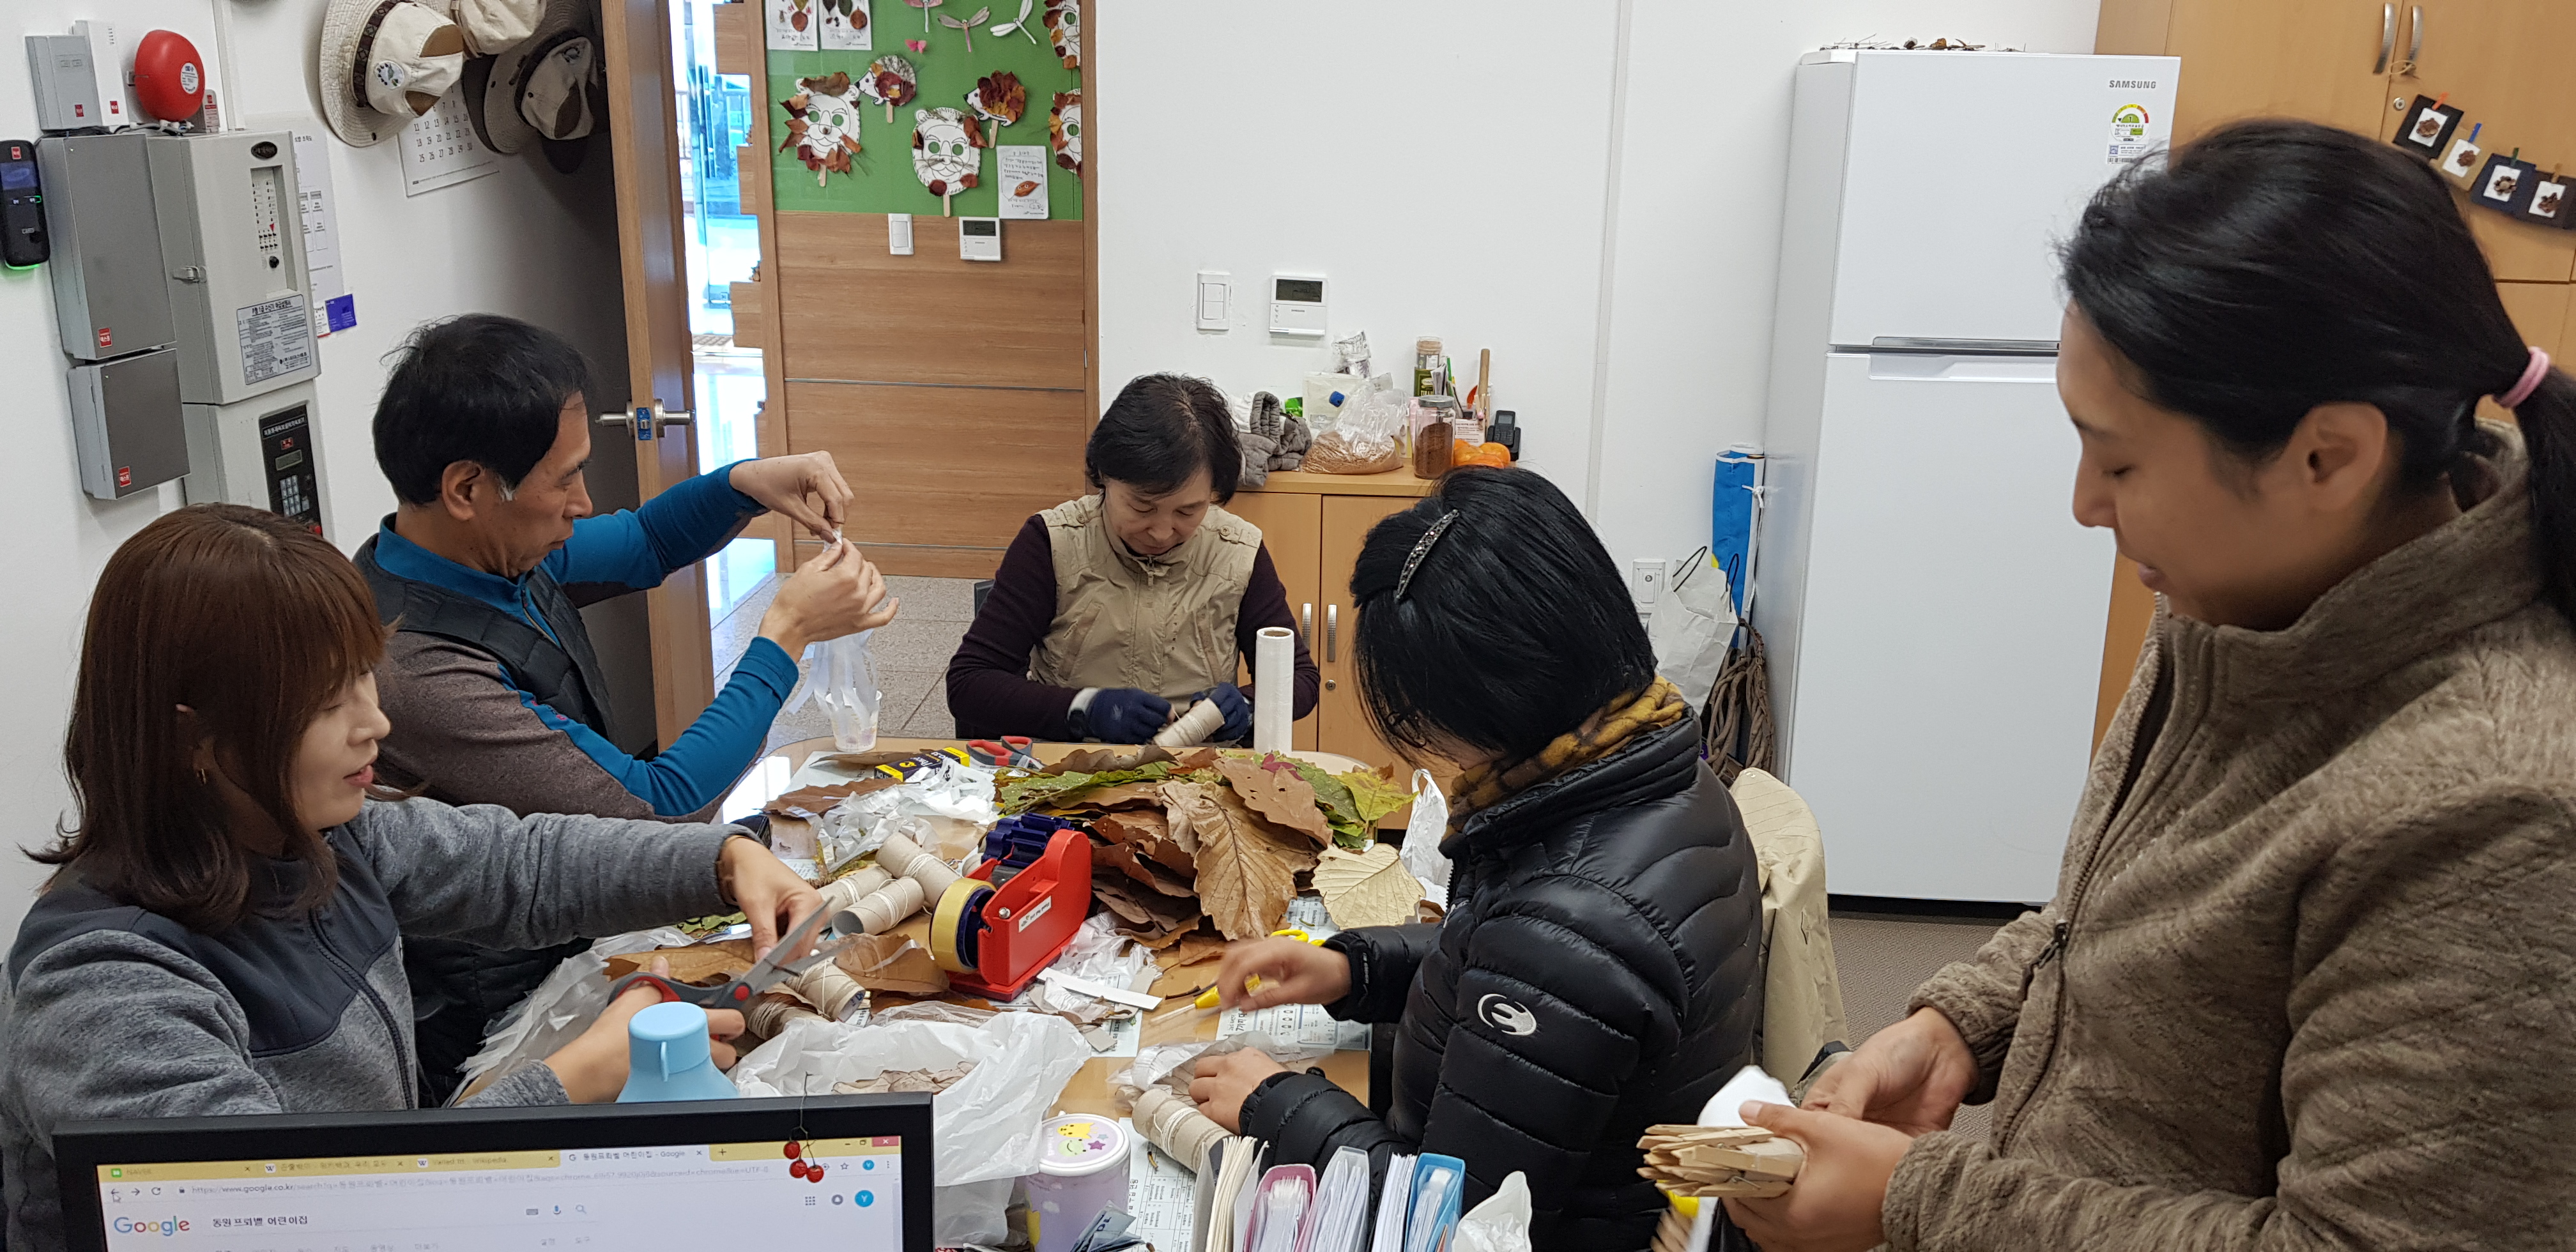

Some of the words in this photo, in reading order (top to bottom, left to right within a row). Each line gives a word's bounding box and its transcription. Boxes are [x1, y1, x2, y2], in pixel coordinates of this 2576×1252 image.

[2109, 80, 2156, 89] SAMSUNG
[413, 123, 420, 132] 11
[424, 120, 430, 130] 12
[434, 118, 440, 128] 13
[444, 116, 449, 125] 14
[453, 114, 459, 123] 15
[416, 138, 422, 148] 18
[426, 136, 432, 145] 19
[436, 134, 442, 142] 20
[445, 132, 452, 141] 21
[455, 129, 461, 139] 22
[419, 153, 425, 163] 25
[429, 151, 435, 160] 26
[438, 149, 443, 158] 27
[448, 146, 454, 155] 28
[457, 144, 463, 153] 29
[467, 142, 473, 151] 30
[660, 1150, 686, 1158] Google
[113, 1216, 190, 1237] Google
[267, 1216, 308, 1226] 어린이집
